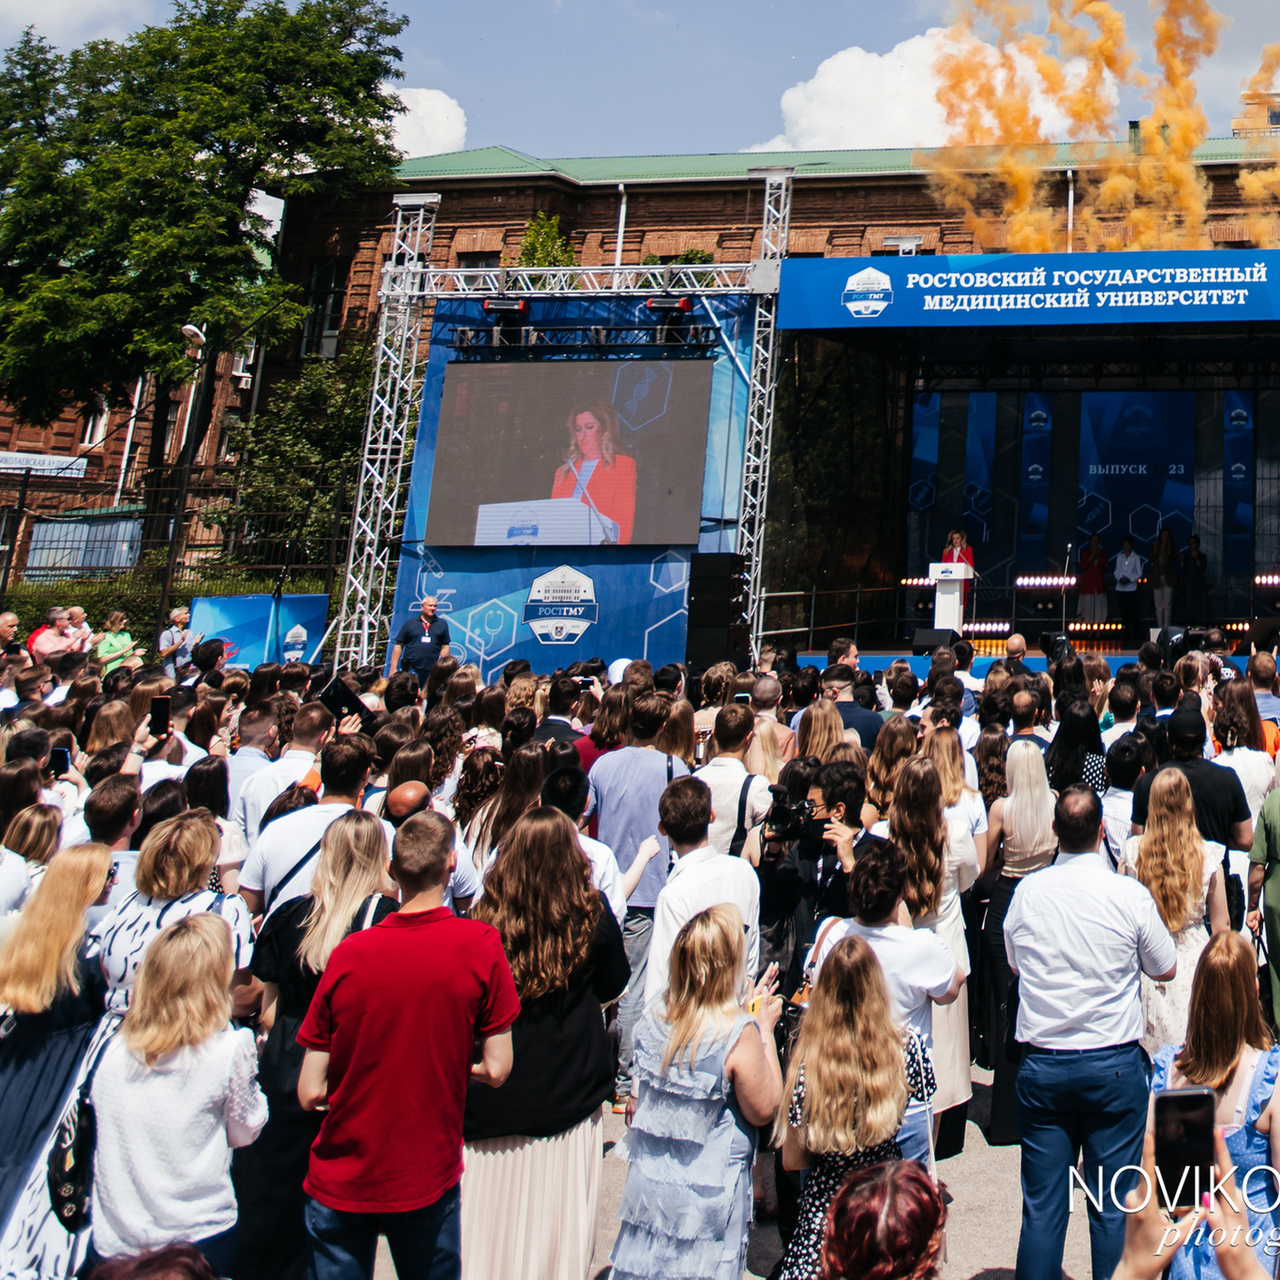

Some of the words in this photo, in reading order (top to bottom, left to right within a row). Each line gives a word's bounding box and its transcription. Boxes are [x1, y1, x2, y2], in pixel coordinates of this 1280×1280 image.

[906, 266, 1046, 288] РОСТОВСКИЙ
[1052, 262, 1267, 286] ГОСУДАРСТВЕННЫЙ
[923, 288, 1089, 311] МЕДИЦИНСКИЙ
[1096, 288, 1249, 307] УНИВЕРСИТЕТ
[1089, 464, 1147, 474] ВЫПУСК
[538, 607, 585, 615] РОСТГМУ
